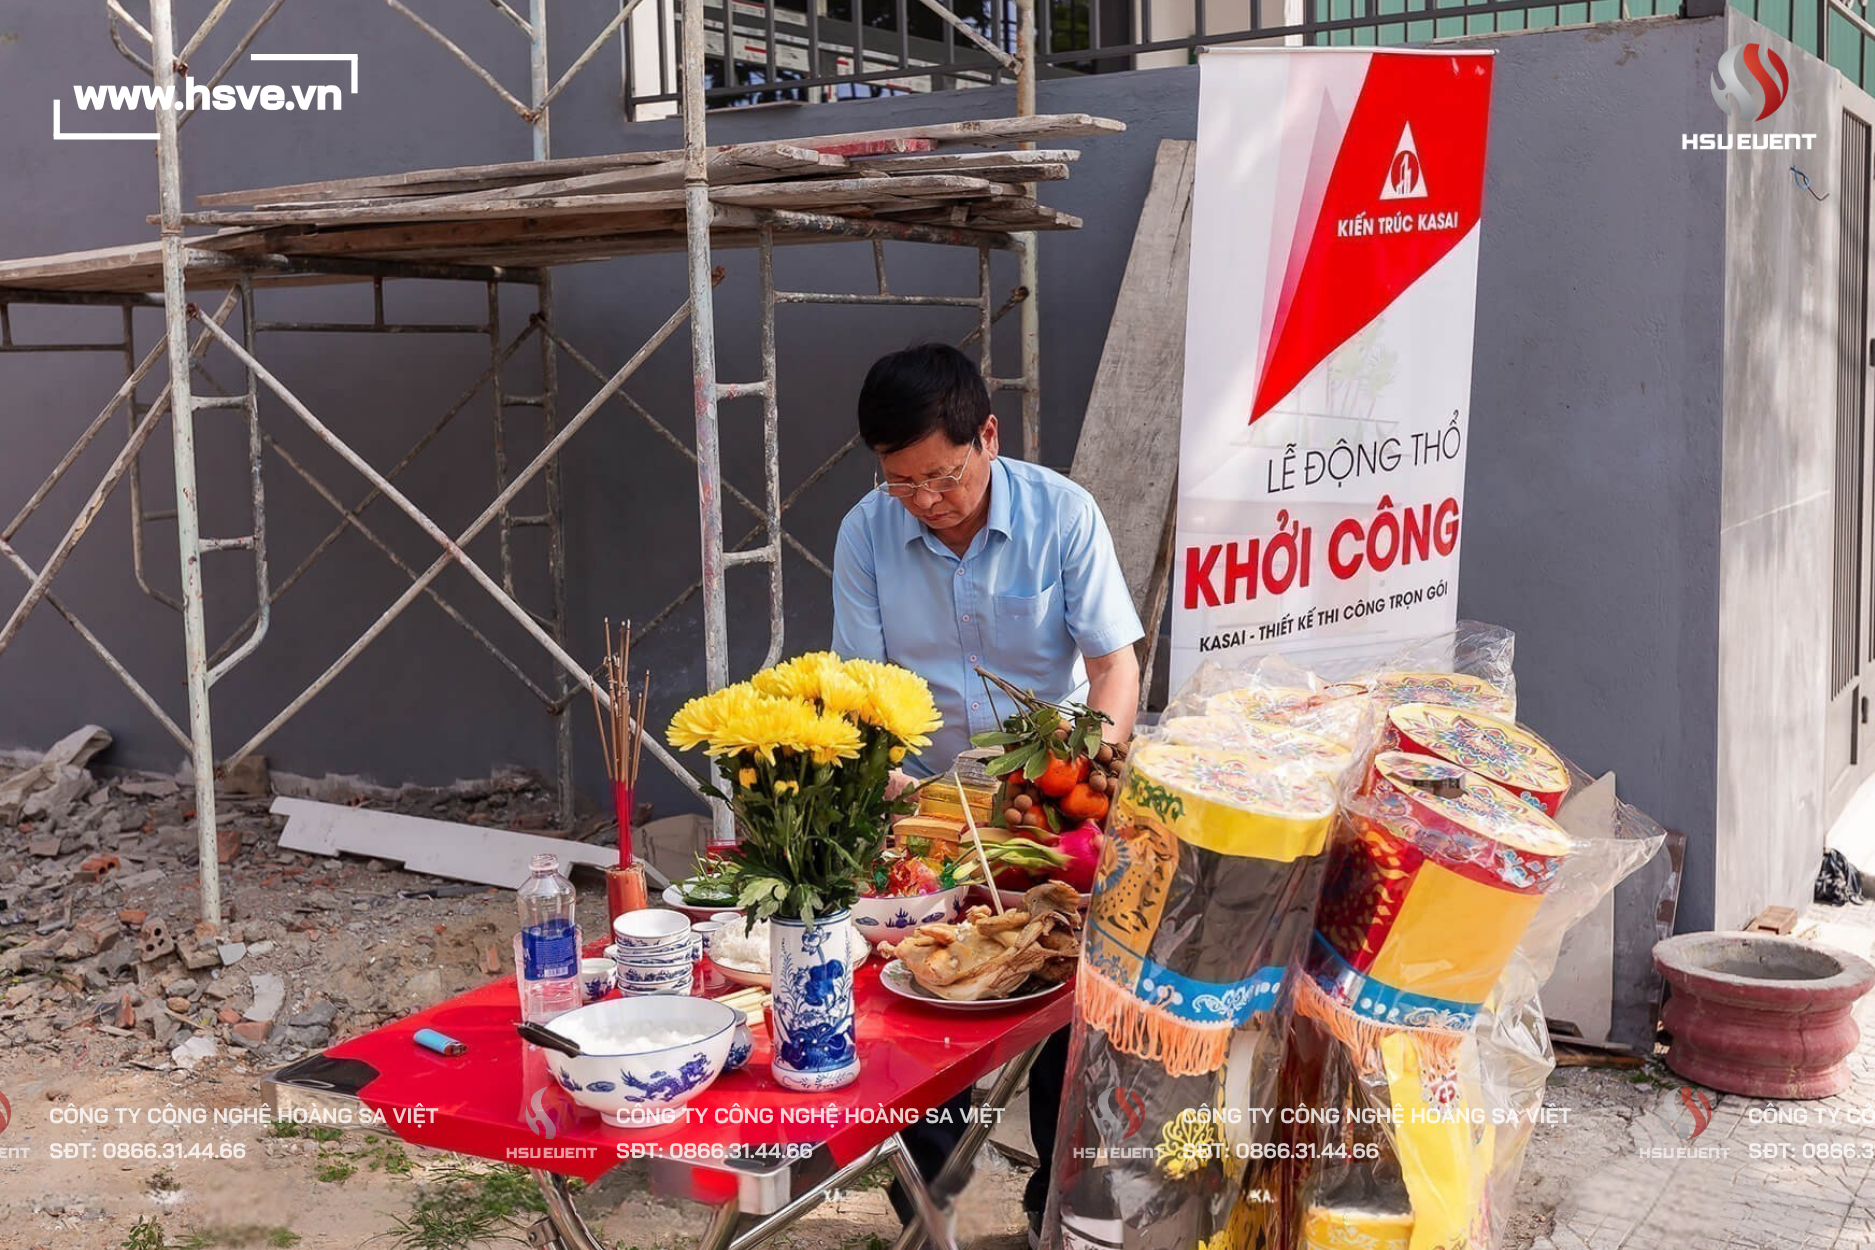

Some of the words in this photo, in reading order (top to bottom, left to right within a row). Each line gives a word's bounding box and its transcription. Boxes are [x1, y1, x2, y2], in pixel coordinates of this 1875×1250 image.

[1337, 211, 1375, 237] KIẾN
[1378, 211, 1414, 235] TRÚC
[1417, 211, 1459, 231] KASAI
[1267, 443, 1297, 493] LỄ
[1304, 438, 1401, 488] ĐỘNG
[1411, 409, 1462, 466] THỔ
[1184, 509, 1312, 609] KHỞI
[1328, 494, 1460, 580] CÔNG
[1200, 630, 1246, 652] KASAI
[1259, 613, 1294, 641] THIẾT
[1298, 606, 1317, 631] KẾ
[1318, 608, 1339, 626] THI
[1343, 599, 1385, 620] CÔNG
[1389, 589, 1423, 610] TRỌN
[1427, 581, 1448, 600] GÓI
